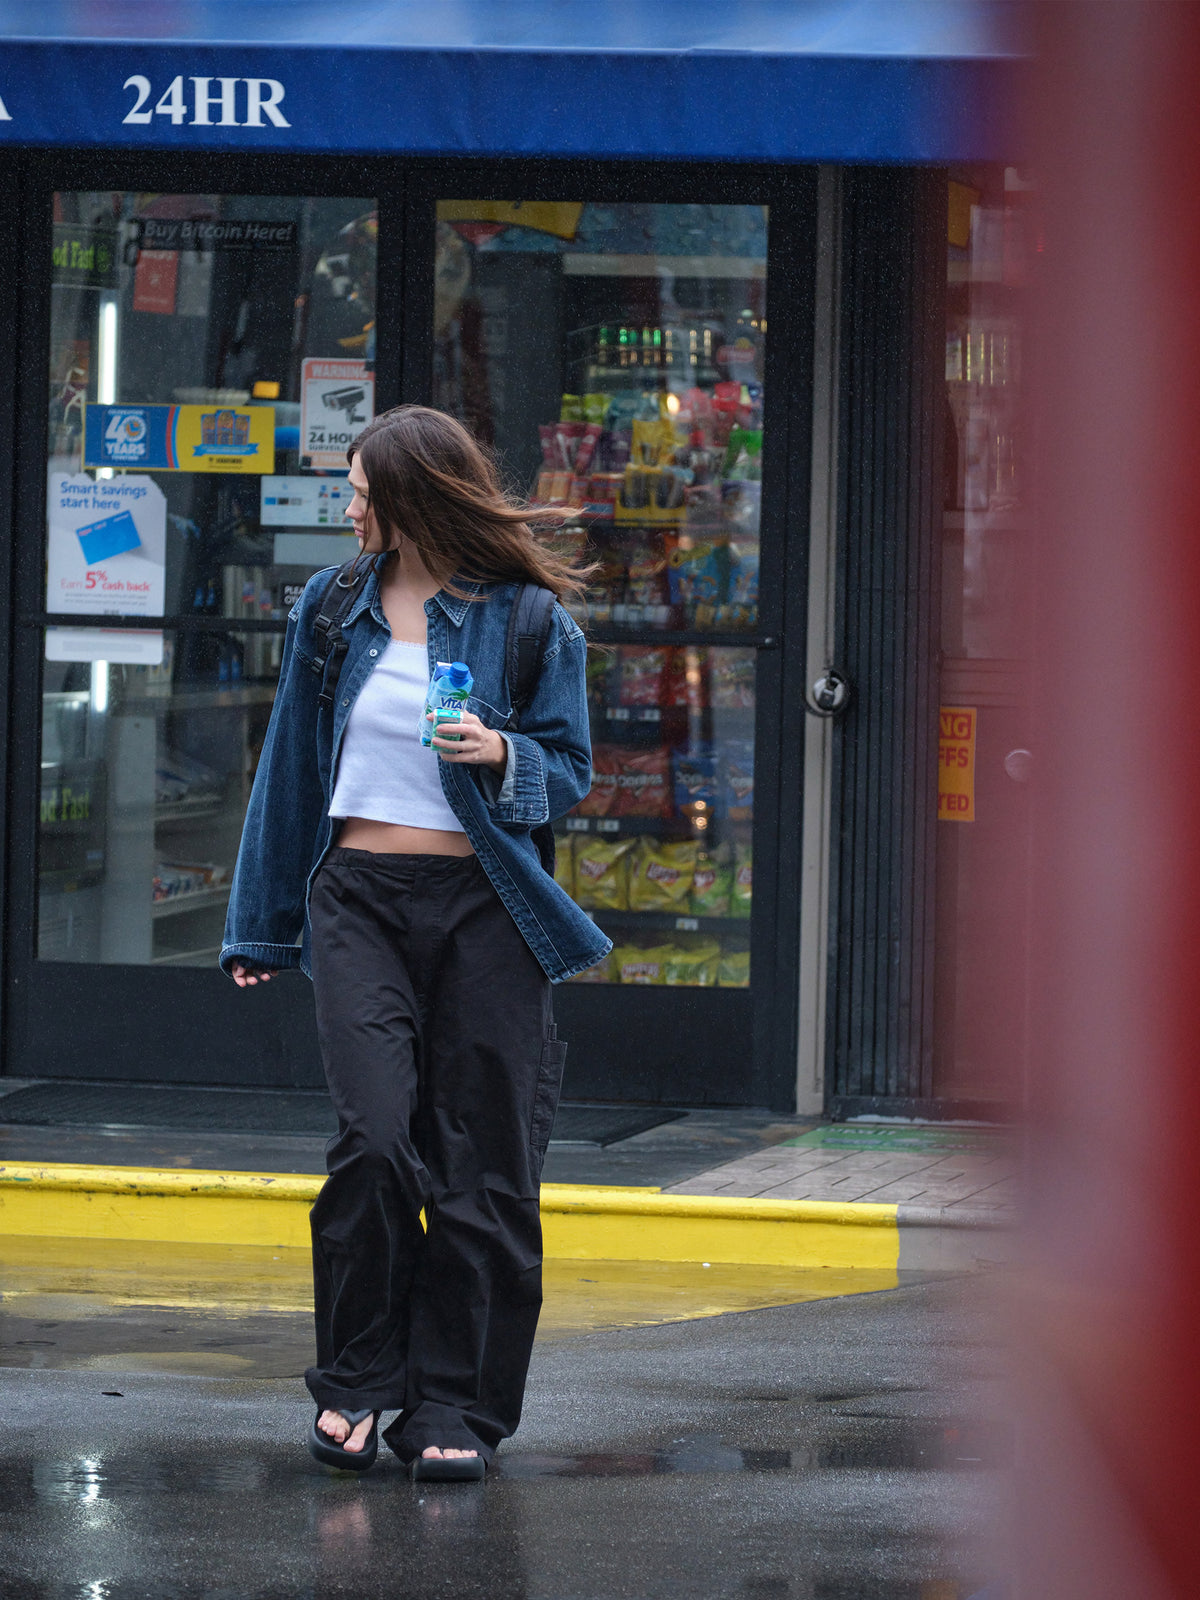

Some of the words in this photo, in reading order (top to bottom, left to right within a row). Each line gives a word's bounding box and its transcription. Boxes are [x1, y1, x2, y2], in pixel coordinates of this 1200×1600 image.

[122, 74, 292, 128] 24HR
[144, 220, 178, 240] Buy
[180, 221, 242, 240] Bitcoin
[244, 223, 293, 241] Here!
[311, 364, 369, 378] WARNING
[105, 415, 146, 444] 40
[308, 431, 325, 443] 24
[105, 442, 145, 456] YEARS
[60, 481, 98, 495] Smart
[101, 483, 147, 500] savings
[60, 497, 89, 508] start
[92, 497, 120, 509] here
[60, 578, 83, 589] Earn
[85, 570, 108, 590] 5%
[102, 580, 124, 591] cash
[441, 697, 463, 710] VITA
